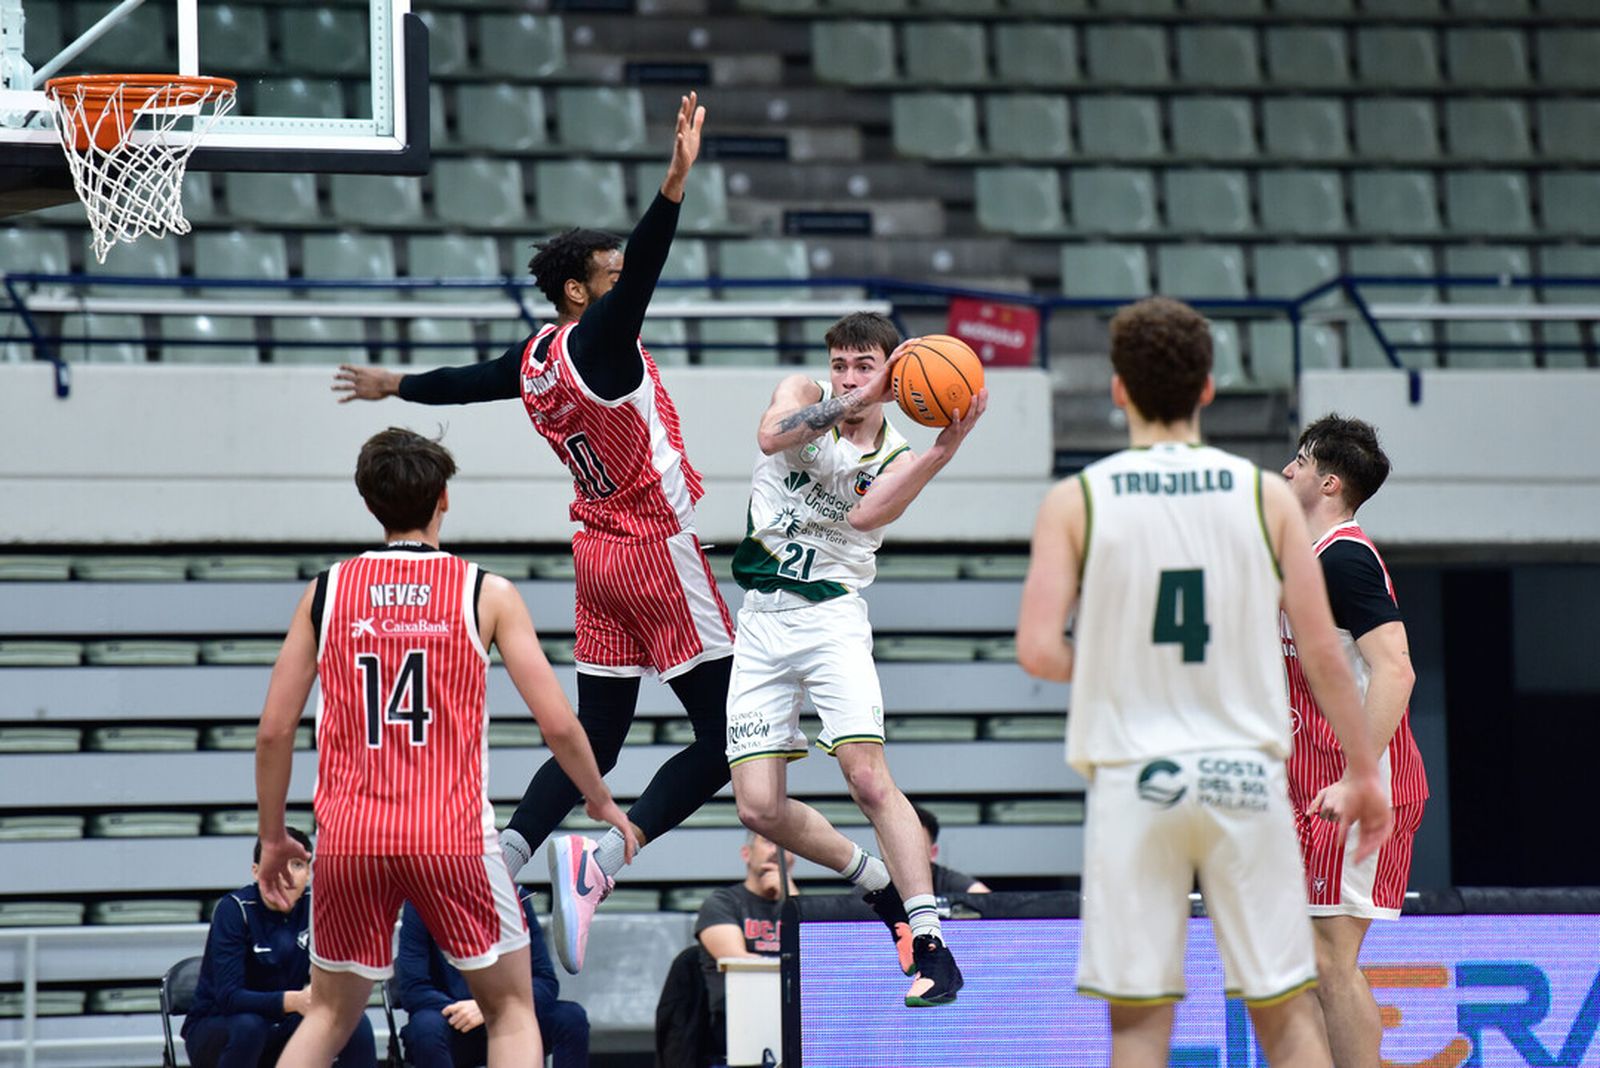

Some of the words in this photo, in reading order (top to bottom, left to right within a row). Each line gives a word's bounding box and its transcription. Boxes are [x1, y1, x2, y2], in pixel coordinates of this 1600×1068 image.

[1111, 469, 1234, 495] TRUJILLO
[804, 493, 845, 523] Unicaja
[778, 542, 817, 582] 21
[369, 583, 432, 608] NEVES
[381, 619, 449, 634] CaixaBank
[1153, 568, 1211, 664] 4
[355, 648, 433, 748] 14
[1198, 758, 1267, 777] COSTA
